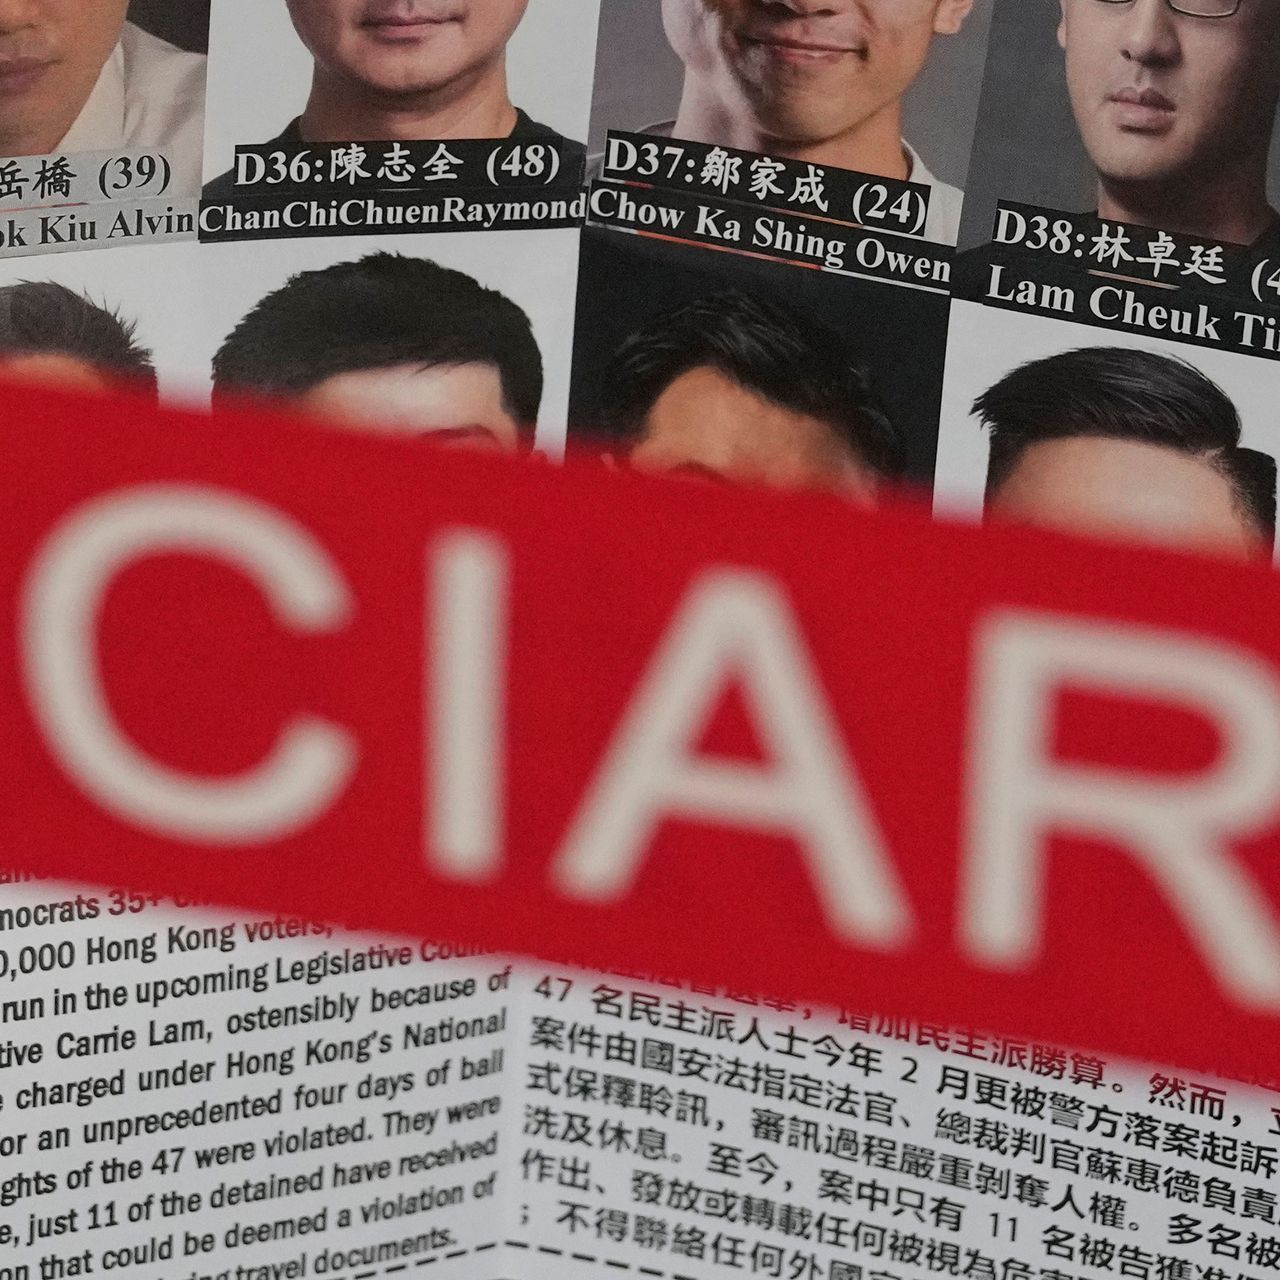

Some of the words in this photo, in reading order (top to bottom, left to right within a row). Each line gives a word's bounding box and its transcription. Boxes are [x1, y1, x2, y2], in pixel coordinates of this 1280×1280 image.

[98, 157, 172, 198] (39)
[234, 143, 463, 186] D36:陳志全
[485, 145, 561, 185] (48)
[606, 138, 828, 212] D37:鄒家成
[851, 182, 927, 233] (24)
[38, 214, 97, 246] Kiu
[106, 206, 194, 239] Alvin
[199, 196, 587, 234] ChanChiChuenRaymond
[590, 189, 684, 229] Chow
[695, 209, 741, 241] Ka
[752, 217, 845, 267] Shing
[854, 238, 951, 283] Owen
[994, 207, 1227, 285] D38:林卓廷
[986, 266, 1075, 308] Lam
[1089, 285, 1220, 340] Cheuk
[86, 932, 157, 964] Hong
[168, 921, 236, 954] Kong
[3, 996, 46, 1021] run
[54, 988, 78, 1014] in
[85, 982, 128, 1010] the
[534, 975, 573, 1002] 47
[591, 984, 883, 1078] 名民主派人士今年
[900, 1057, 919, 1084] 2
[989, 1212, 1017, 1241] 11
